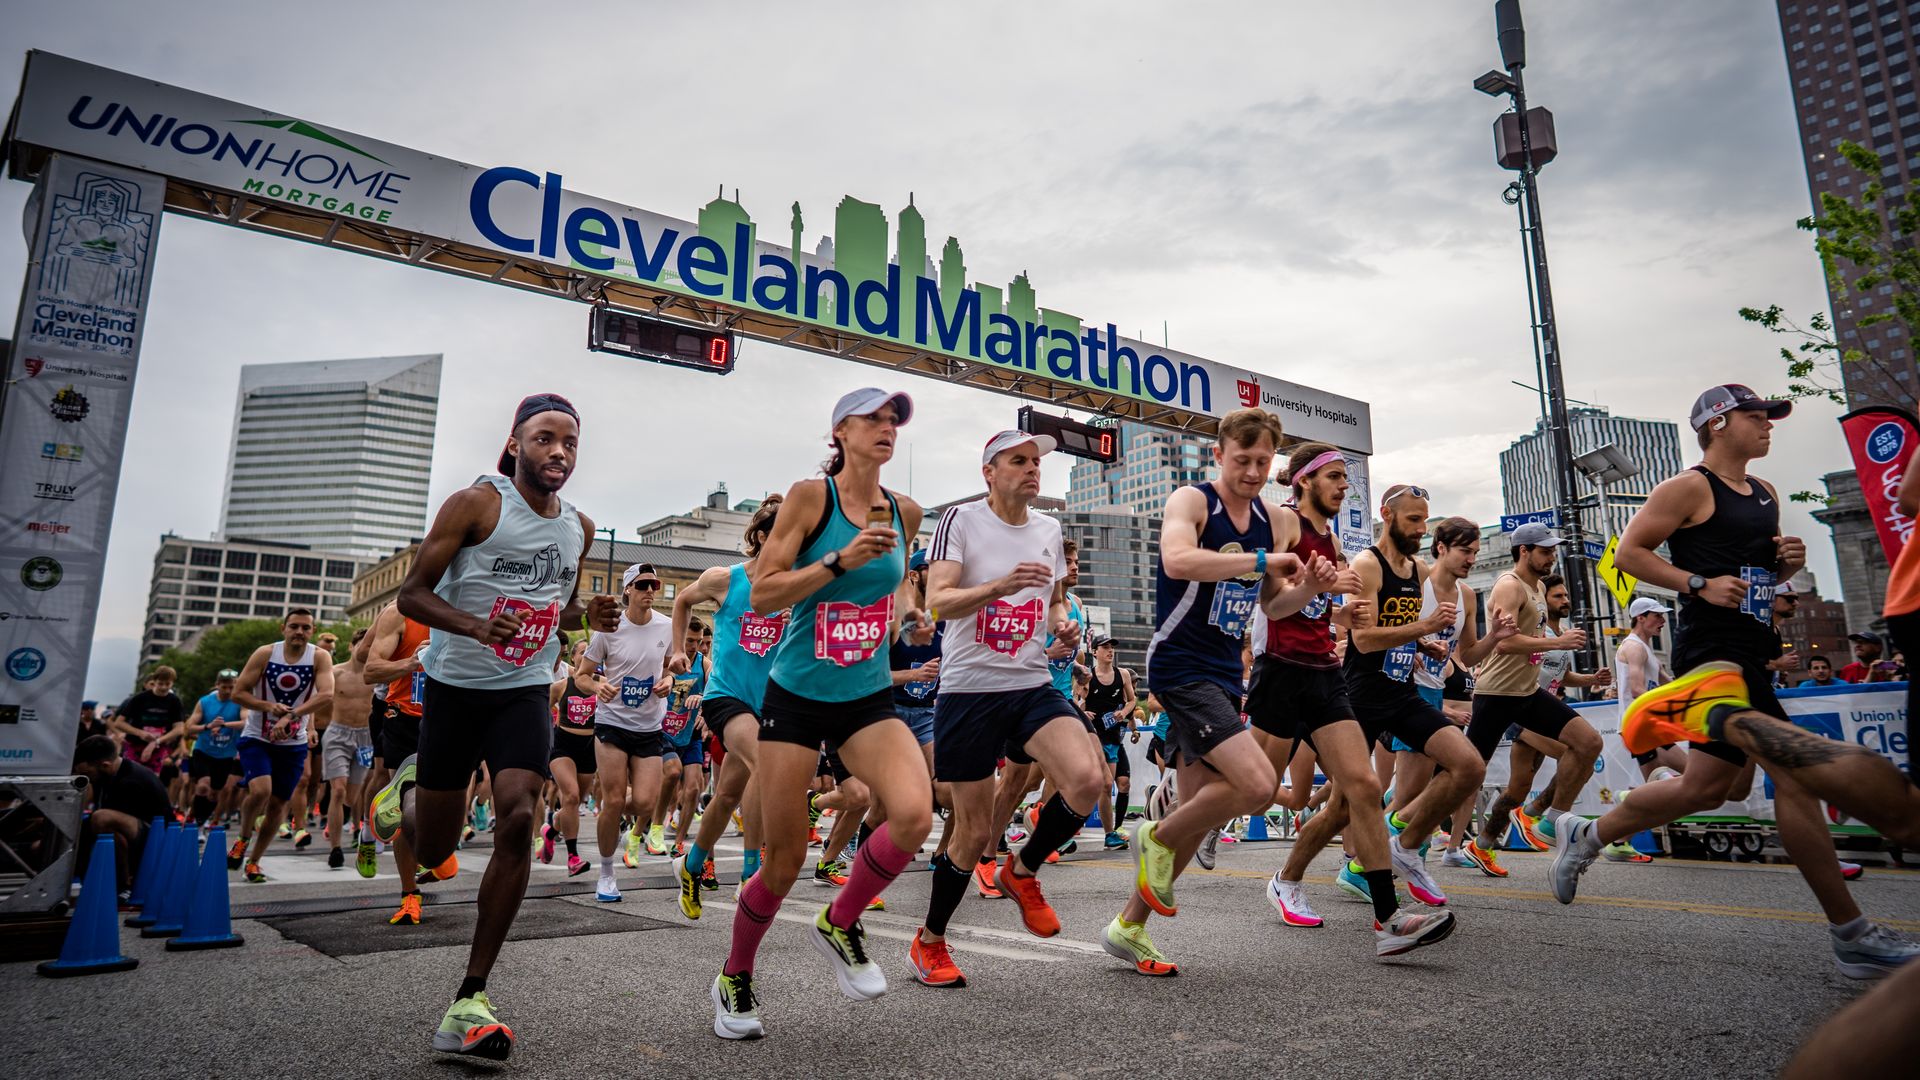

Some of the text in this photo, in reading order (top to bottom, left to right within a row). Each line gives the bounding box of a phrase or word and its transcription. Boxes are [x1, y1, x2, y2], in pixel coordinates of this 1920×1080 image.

[243, 178, 392, 223] MORTGAGE
[470, 166, 1212, 412] Cleveland Marathon
[38, 295, 137, 318] Union Home Mortgage
[36, 303, 137, 333] Cleveland
[32, 319, 133, 349] Marathon
[45, 362, 88, 377] University
[90, 369, 128, 382] Hospitals
[1262, 391, 1357, 426] University Hospitals
[1877, 439, 1898, 456] 1978
[34, 482, 77, 495] TRULY
[28, 520, 71, 535] meijer
[1342, 532, 1372, 546] Cleveland
[1226, 599, 1253, 615] 1424
[744, 625, 777, 639] 5692
[831, 621, 881, 641] 4036
[989, 616, 1029, 634] 4754
[1390, 652, 1414, 665] 1977
[623, 686, 649, 696] 2046
[570, 704, 592, 714] 4536
[1850, 710, 1895, 722] Union
[664, 717, 684, 728] 3042
